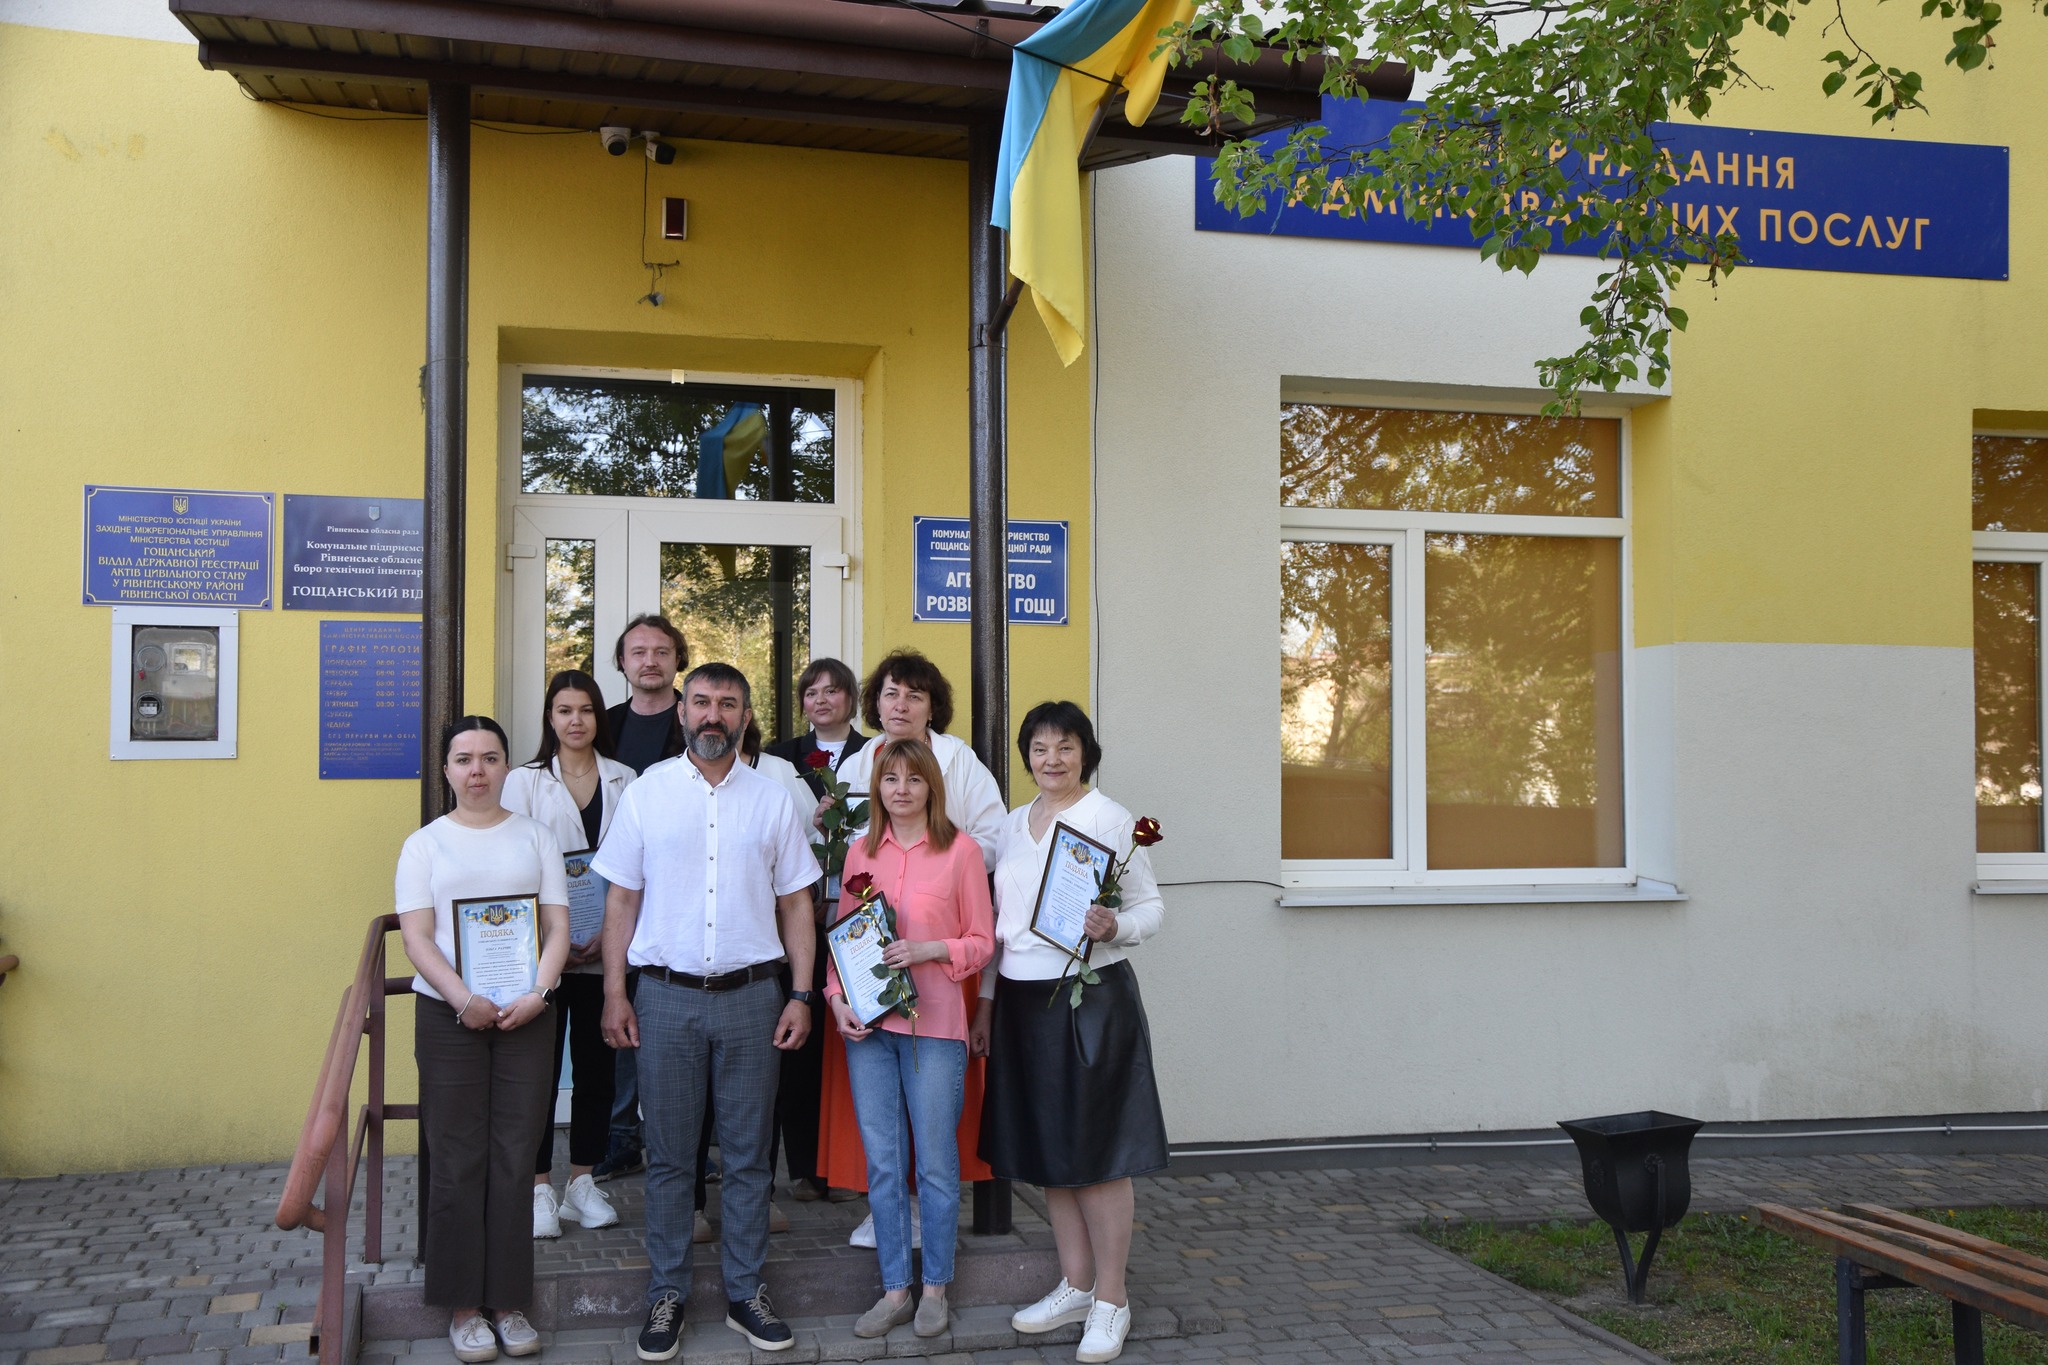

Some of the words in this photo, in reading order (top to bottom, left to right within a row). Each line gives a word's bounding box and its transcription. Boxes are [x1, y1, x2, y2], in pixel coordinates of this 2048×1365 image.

[1759, 208, 1930, 251] ПОСЛУГ
[118, 515, 174, 524] МІНІСТЕРСТВО
[176, 517, 208, 526] ЮСТИЦІЇ
[210, 517, 242, 527] УКРАЇНИ
[96, 525, 132, 534] ЗАХІДНЕ
[134, 526, 209, 537] МІЖРЕГІОНАЛЬНЕ
[211, 529, 263, 538] УПРАВЛІННЯ
[327, 525, 369, 534] Рівненська
[370, 526, 401, 535] обласна
[402, 528, 420, 537] рада
[932, 529, 971, 539] КОМУНАЛ
[1008, 531, 1050, 542] РИЄМСТВО
[130, 535, 191, 545] МІНІСТЕРСТВА
[194, 537, 230, 547] ЮСТИЦІЇ
[306, 540, 368, 551] Комунальне
[930, 541, 970, 552] ГОЩАНСЬ
[1029, 544, 1052, 554] РАДИ
[144, 547, 216, 558] ГОЩАНСЬКИЙ
[320, 553, 379, 563] Рівненське
[381, 554, 423, 565] обласне
[98, 556, 133, 567] ВІДДІЛ
[135, 557, 198, 568] ДЕРЖАВНОЇ
[201, 559, 259, 570] РЕЄСТРАЦІЇ
[110, 567, 141, 577] АКТІВ
[144, 569, 211, 580] ЦИВІЛЬНОГО
[213, 570, 247, 581] СТАНУ
[293, 564, 322, 575] бюро
[324, 565, 375, 575] технічної
[377, 566, 423, 578] інвентар
[112, 578, 120, 588] У
[123, 579, 202, 590] РІВНЕНСЬКОМУ
[205, 580, 244, 591] РАЙОНІ
[120, 589, 189, 600] РІВНЕНСЬКОЇ
[192, 591, 237, 601] ОБЛАСТІ
[292, 585, 398, 599] ГОЩАНСЬКИЙ
[1015, 597, 1055, 616] ГОЩІ
[567, 879, 592, 889] ОДЯКА
[480, 928, 515, 939] ПОДЯКА
